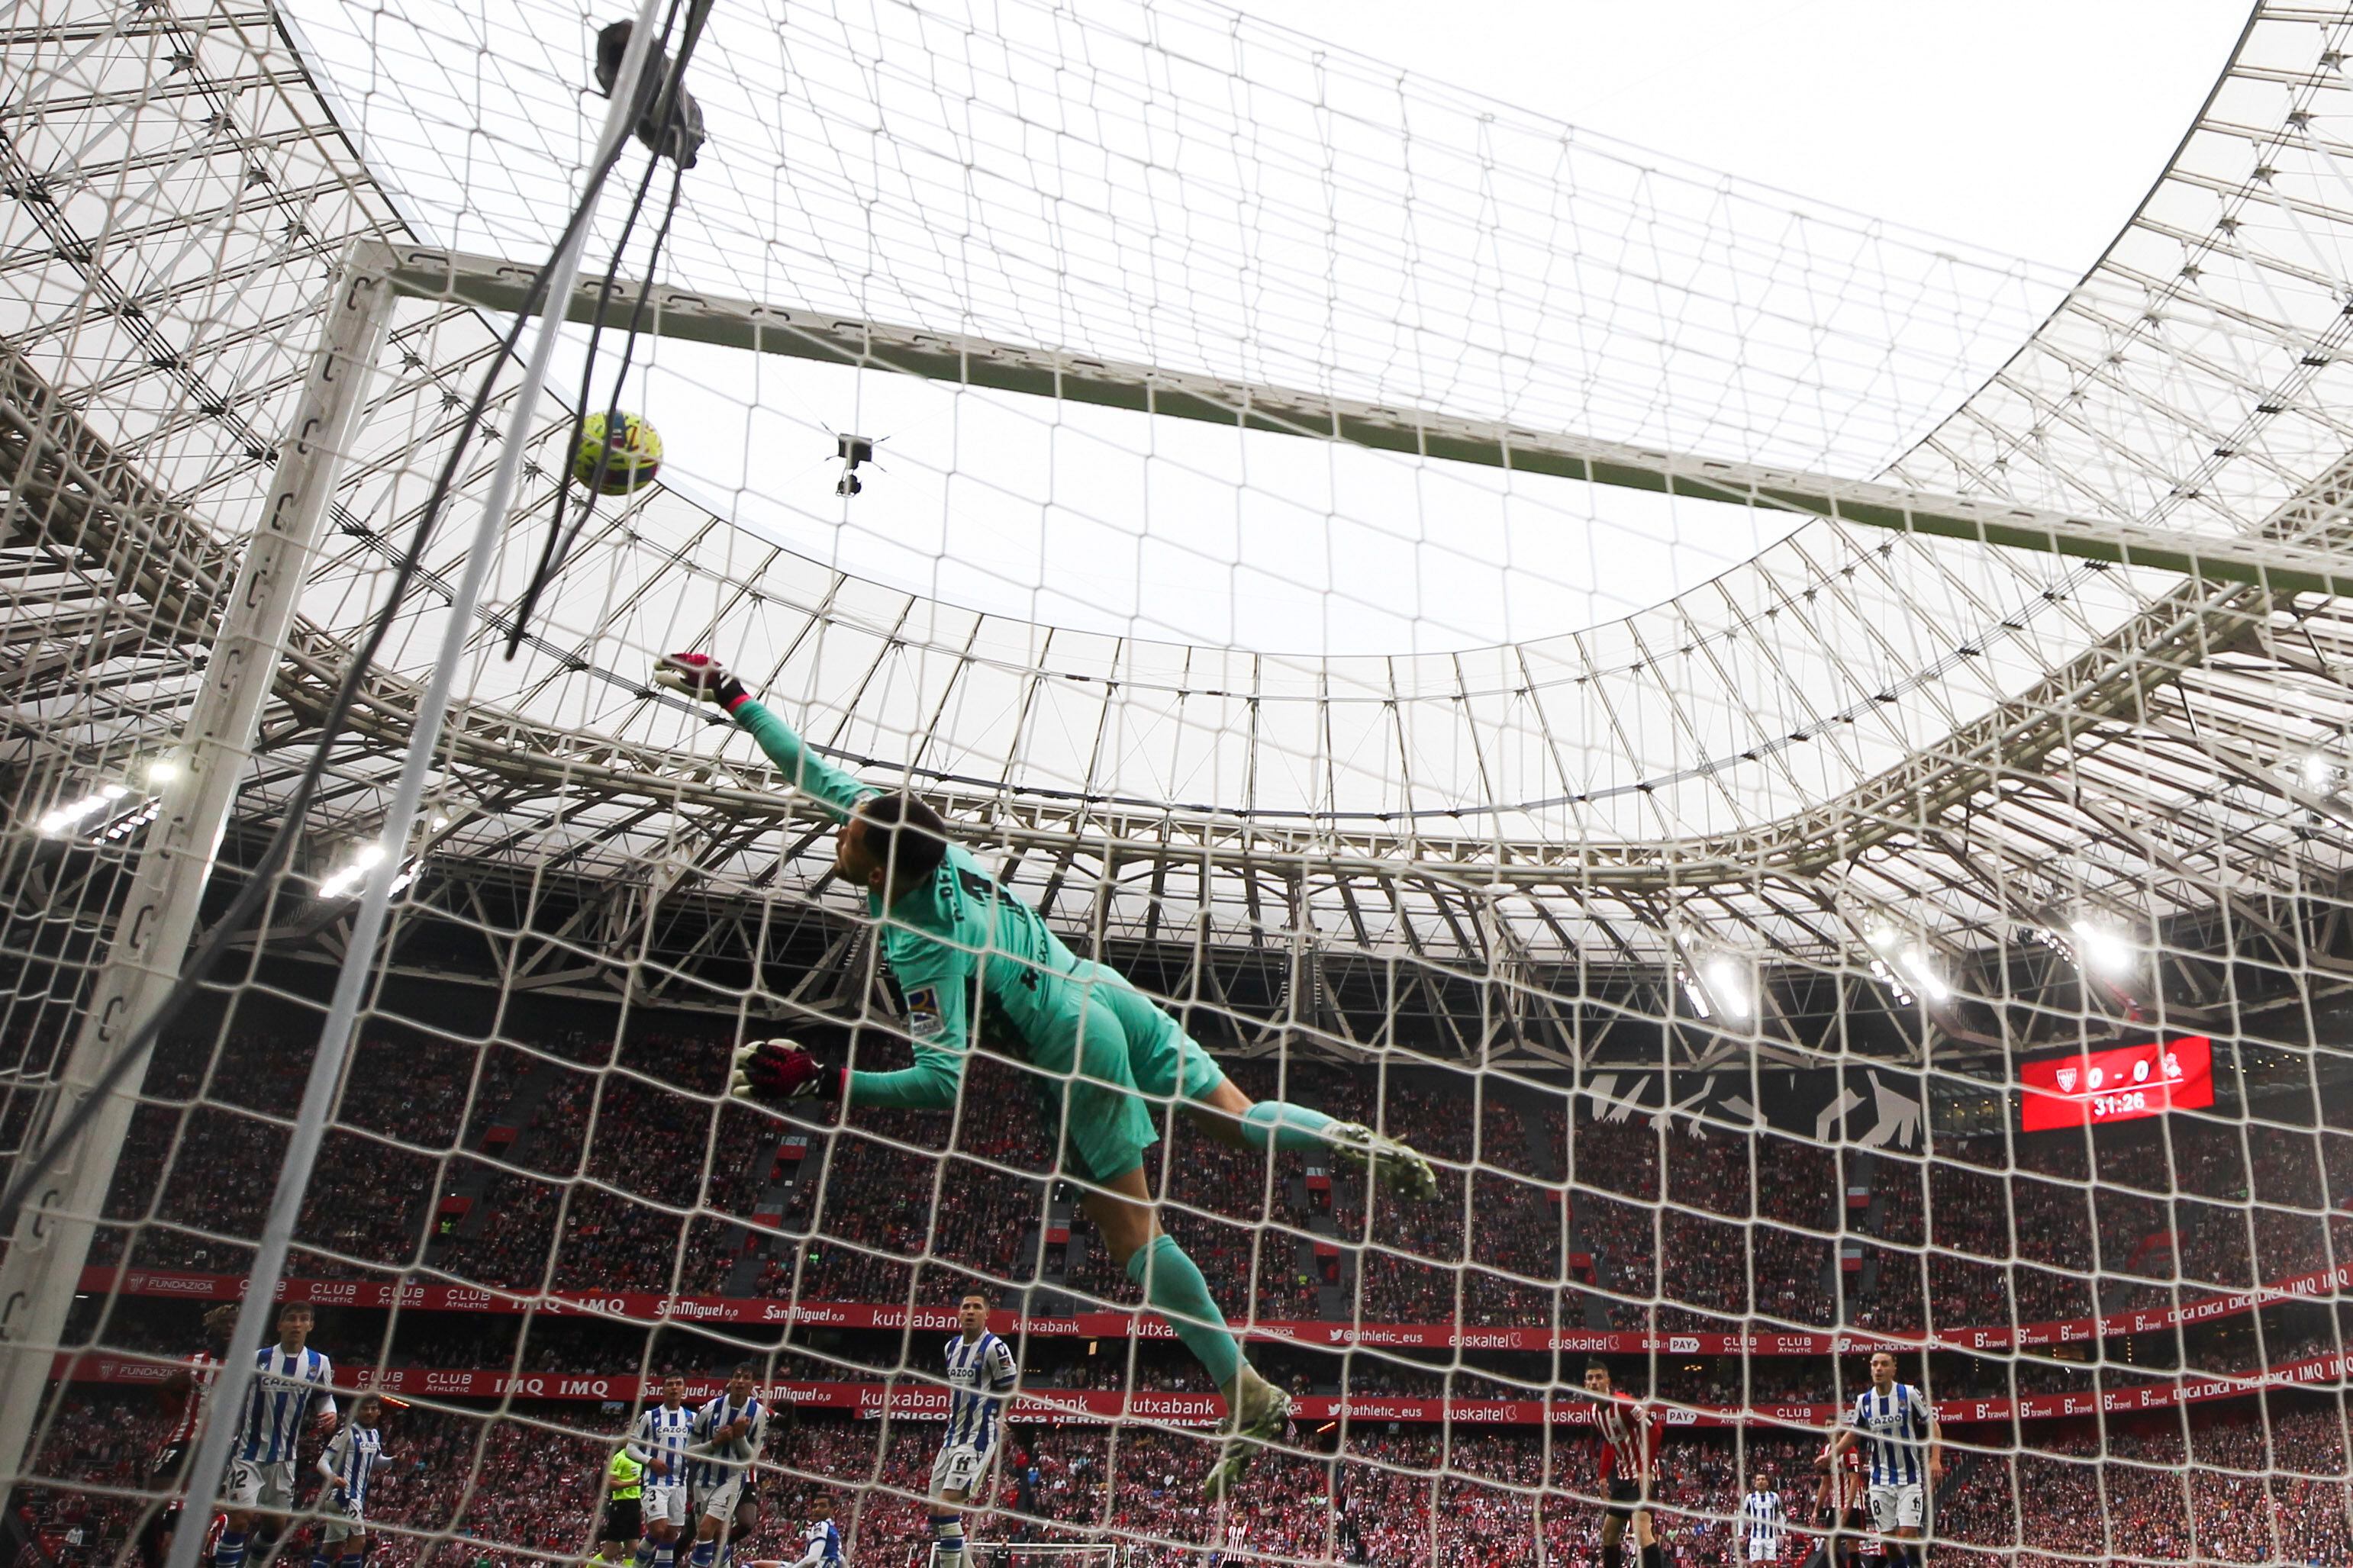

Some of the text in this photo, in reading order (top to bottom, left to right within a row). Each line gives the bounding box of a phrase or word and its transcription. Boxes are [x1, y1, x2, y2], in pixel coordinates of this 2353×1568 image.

[2087, 1067, 2103, 1089] 0
[2133, 1059, 2150, 1082] 0
[2094, 1092, 2145, 1116] 31:26
[148, 1278, 213, 1292] FUNDAZIOA
[240, 1279, 287, 1291] CB
[311, 1283, 356, 1295] CLUB
[2291, 1277, 2317, 1296] IMQ
[446, 1289, 491, 1301] CLUB
[576, 1298, 625, 1315] IMQ
[2168, 1308, 2195, 1323] DIGI
[2198, 1302, 2224, 1318] DIGI
[2229, 1293, 2252, 1310] DIG
[872, 1310, 962, 1328] kutxaban
[1778, 1337, 1812, 1346] CLUB
[2028, 1335, 2048, 1344] travel
[2071, 1331, 2090, 1340] travel
[1449, 1334, 1607, 1351] euskaltel euskaltel
[1852, 1344, 1869, 1352] new
[1986, 1339, 2007, 1347] travel
[120, 1365, 176, 1377] FUNDAZI
[2298, 1363, 2325, 1381] IMQ
[427, 1373, 472, 1384] CLUB
[495, 1378, 609, 1398] IMQ IMQ
[2173, 1385, 2201, 1401] DIGI
[2204, 1381, 2230, 1396] DIGI
[860, 1389, 947, 1408] kuxaban
[1014, 1395, 1088, 1412] txabank
[2113, 1399, 2132, 1410] travel
[1777, 1409, 1811, 1418] CLUB
[1987, 1409, 2009, 1418] travel
[2031, 1407, 2052, 1416] travel
[2074, 1404, 2093, 1413] travel
[1543, 1410, 1591, 1423] euskalt
[1941, 1412, 1963, 1421] travel
[649, 1490, 656, 1502] 3
[1873, 1499, 1881, 1515] 8
